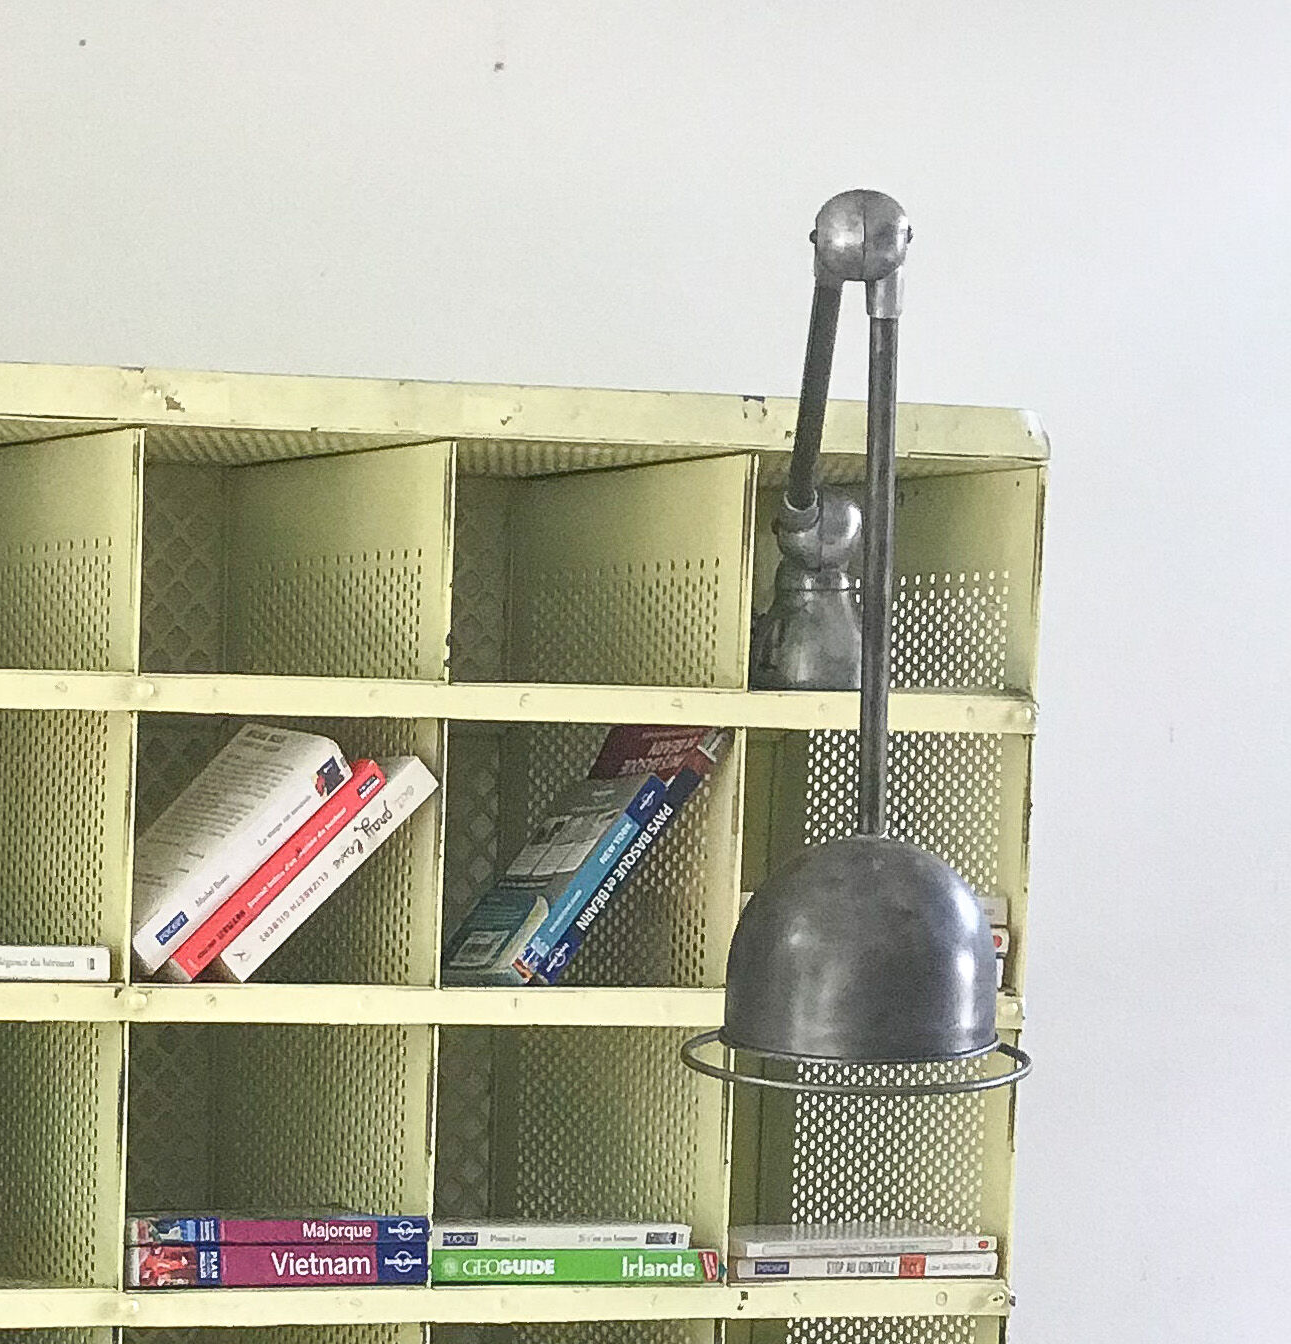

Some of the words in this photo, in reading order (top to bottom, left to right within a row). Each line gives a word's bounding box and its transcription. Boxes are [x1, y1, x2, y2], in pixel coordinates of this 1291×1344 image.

[353, 799, 392, 838] pray
[646, 802, 673, 835] PAYS
[332, 838, 363, 869] love
[611, 830, 652, 881] BASQUE
[603, 876, 616, 891] et
[302, 1222, 372, 1241] Majorque
[270, 1251, 371, 1277] Vietnam
[621, 1255, 696, 1278] Irlande
